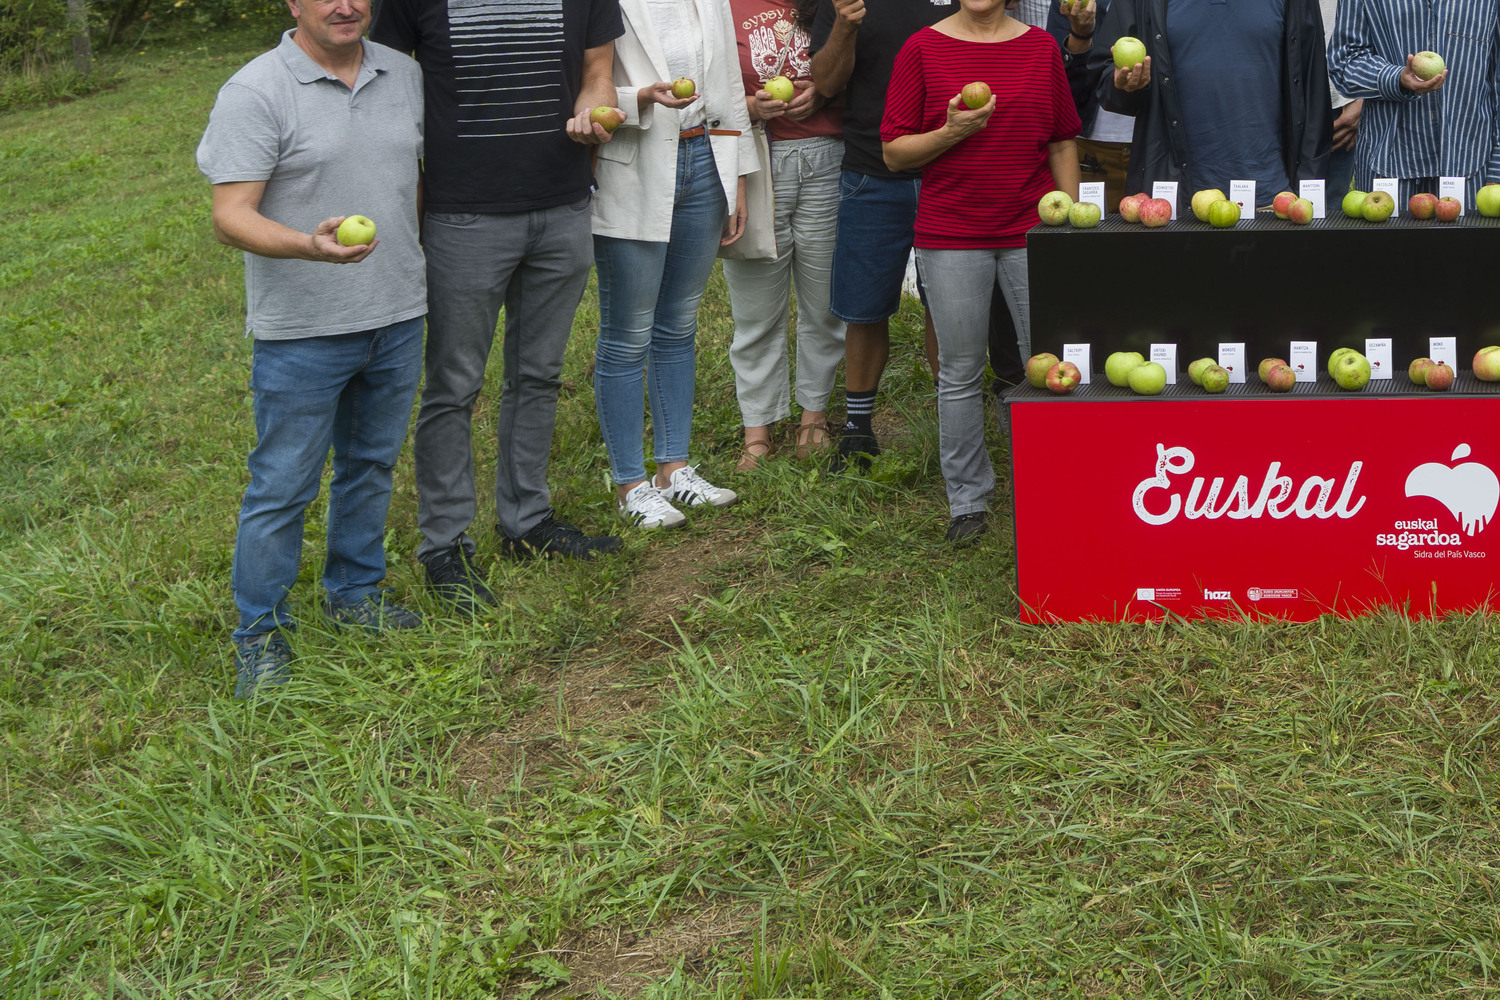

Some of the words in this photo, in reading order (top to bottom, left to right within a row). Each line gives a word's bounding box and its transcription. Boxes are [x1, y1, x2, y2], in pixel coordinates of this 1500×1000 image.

[1132, 443, 1366, 525] Euskal
[1394, 518, 1438, 531] euskal
[1376, 530, 1462, 550] sagardoa
[1414, 550, 1433, 559] Sidra
[1434, 550, 1446, 559] del
[1447, 550, 1462, 559] País
[1464, 550, 1486, 559] Vasco
